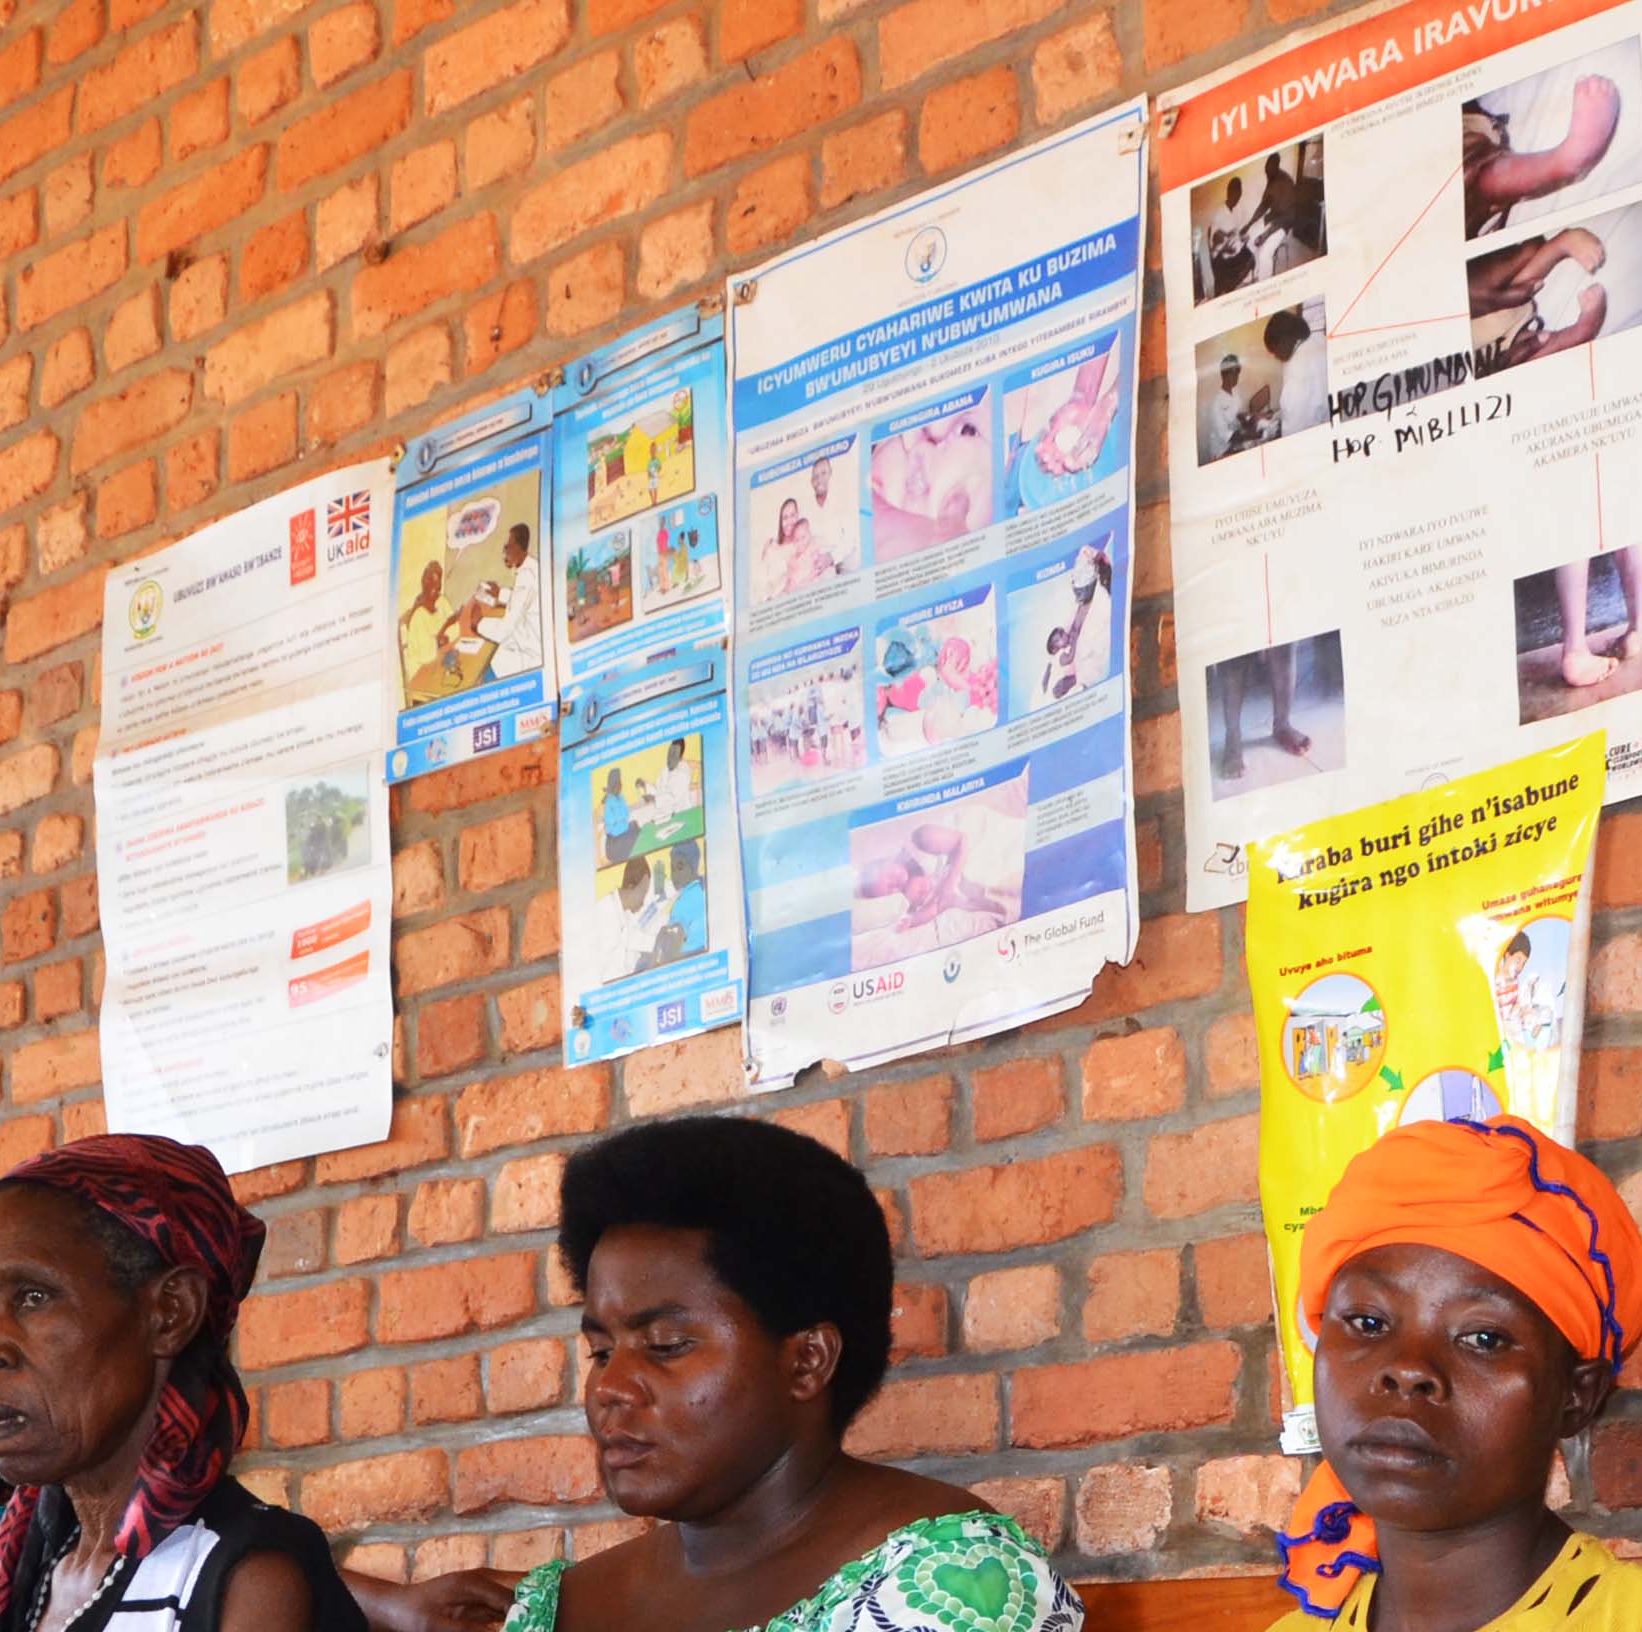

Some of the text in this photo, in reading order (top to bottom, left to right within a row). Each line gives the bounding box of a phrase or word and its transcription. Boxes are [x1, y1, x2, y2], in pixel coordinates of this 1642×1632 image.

[1211, 111, 1248, 145] IYI
[1258, 39, 1405, 124] NDWARA
[757, 340, 852, 395] ICYUMWERU
[856, 302, 955, 352] CYAHARIWE
[959, 279, 1013, 312] KWITA
[1018, 264, 1042, 290] KU
[1047, 233, 1117, 277] BUZIMA
[805, 341, 917, 399] BW'UMUBYEYI
[474, 726, 497, 748] JSI
[1360, 773, 1580, 858] buri gihe n'isabune
[1229, 858, 1249, 876] cb
[1297, 814, 1557, 911] kugira ngo intoki zicye
[1024, 910, 1105, 948] The Global Fund
[1279, 946, 1373, 976] Uvuye aho bituma
[659, 1004, 683, 1028] JSI
